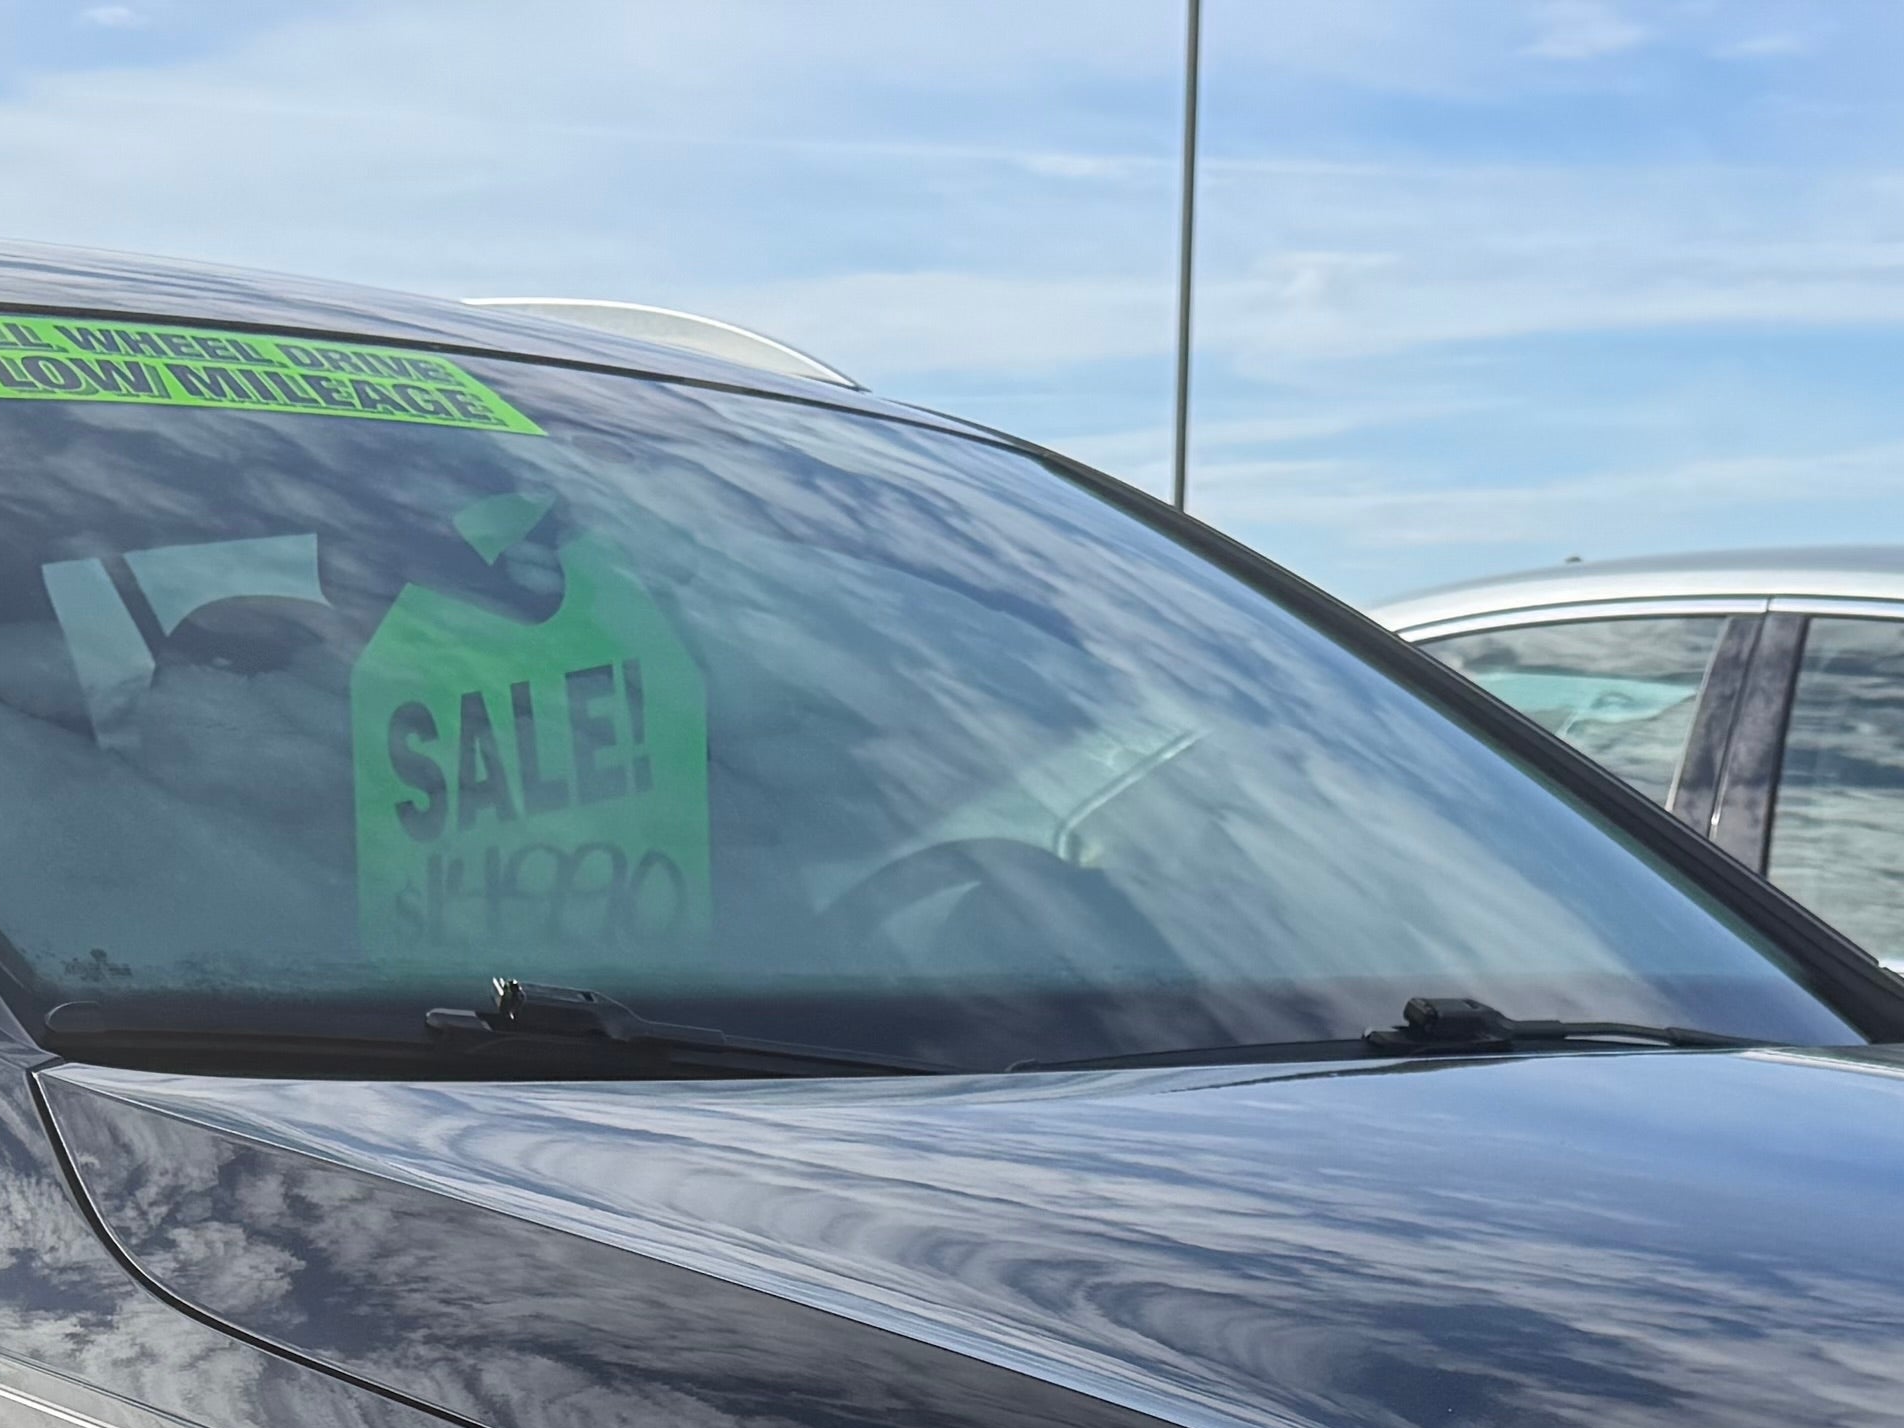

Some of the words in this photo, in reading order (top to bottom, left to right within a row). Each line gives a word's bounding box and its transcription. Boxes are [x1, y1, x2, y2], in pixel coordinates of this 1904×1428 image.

[53, 324, 276, 367] WHEEL
[274, 343, 466, 387] DRIVE
[164, 362, 508, 427] MILEAGE
[386, 658, 653, 843] SALE!
